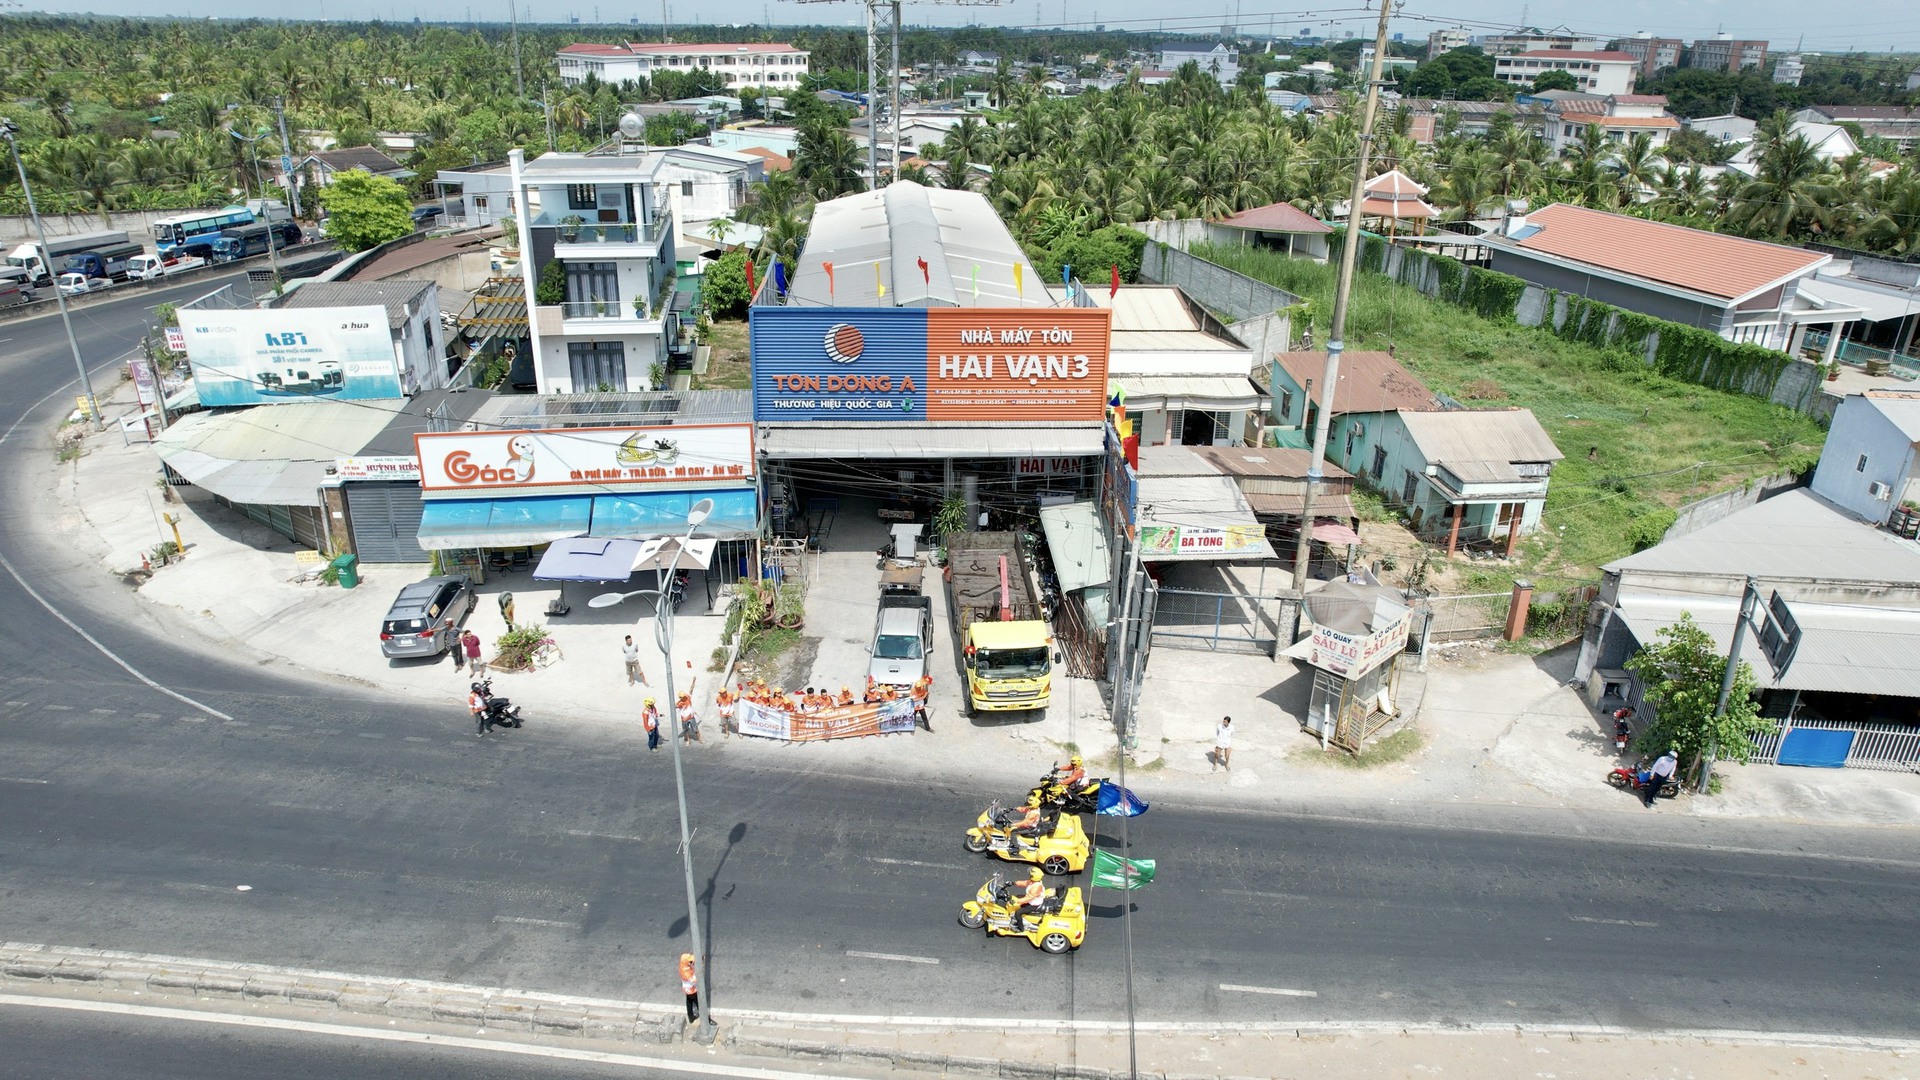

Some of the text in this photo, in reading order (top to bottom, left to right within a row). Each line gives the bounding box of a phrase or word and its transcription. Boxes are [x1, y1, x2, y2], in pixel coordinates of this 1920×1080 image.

[961, 327, 1073, 344] NHÀ MÁY TÔN
[939, 354, 994, 379] HAI
[773, 397, 893, 410] THƯƠNG HIỆU QUỐC GIA
[366, 462, 396, 472] HUỲNH
[584, 468, 601, 479] PHÊ
[603, 468, 621, 479] MÁY
[629, 467, 647, 478] TRÀ
[648, 466, 667, 478] SỮA
[1020, 458, 1081, 475] HAI VẠN
[1181, 537, 1195, 547] BA
[1333, 633, 1352, 644] QUAY
